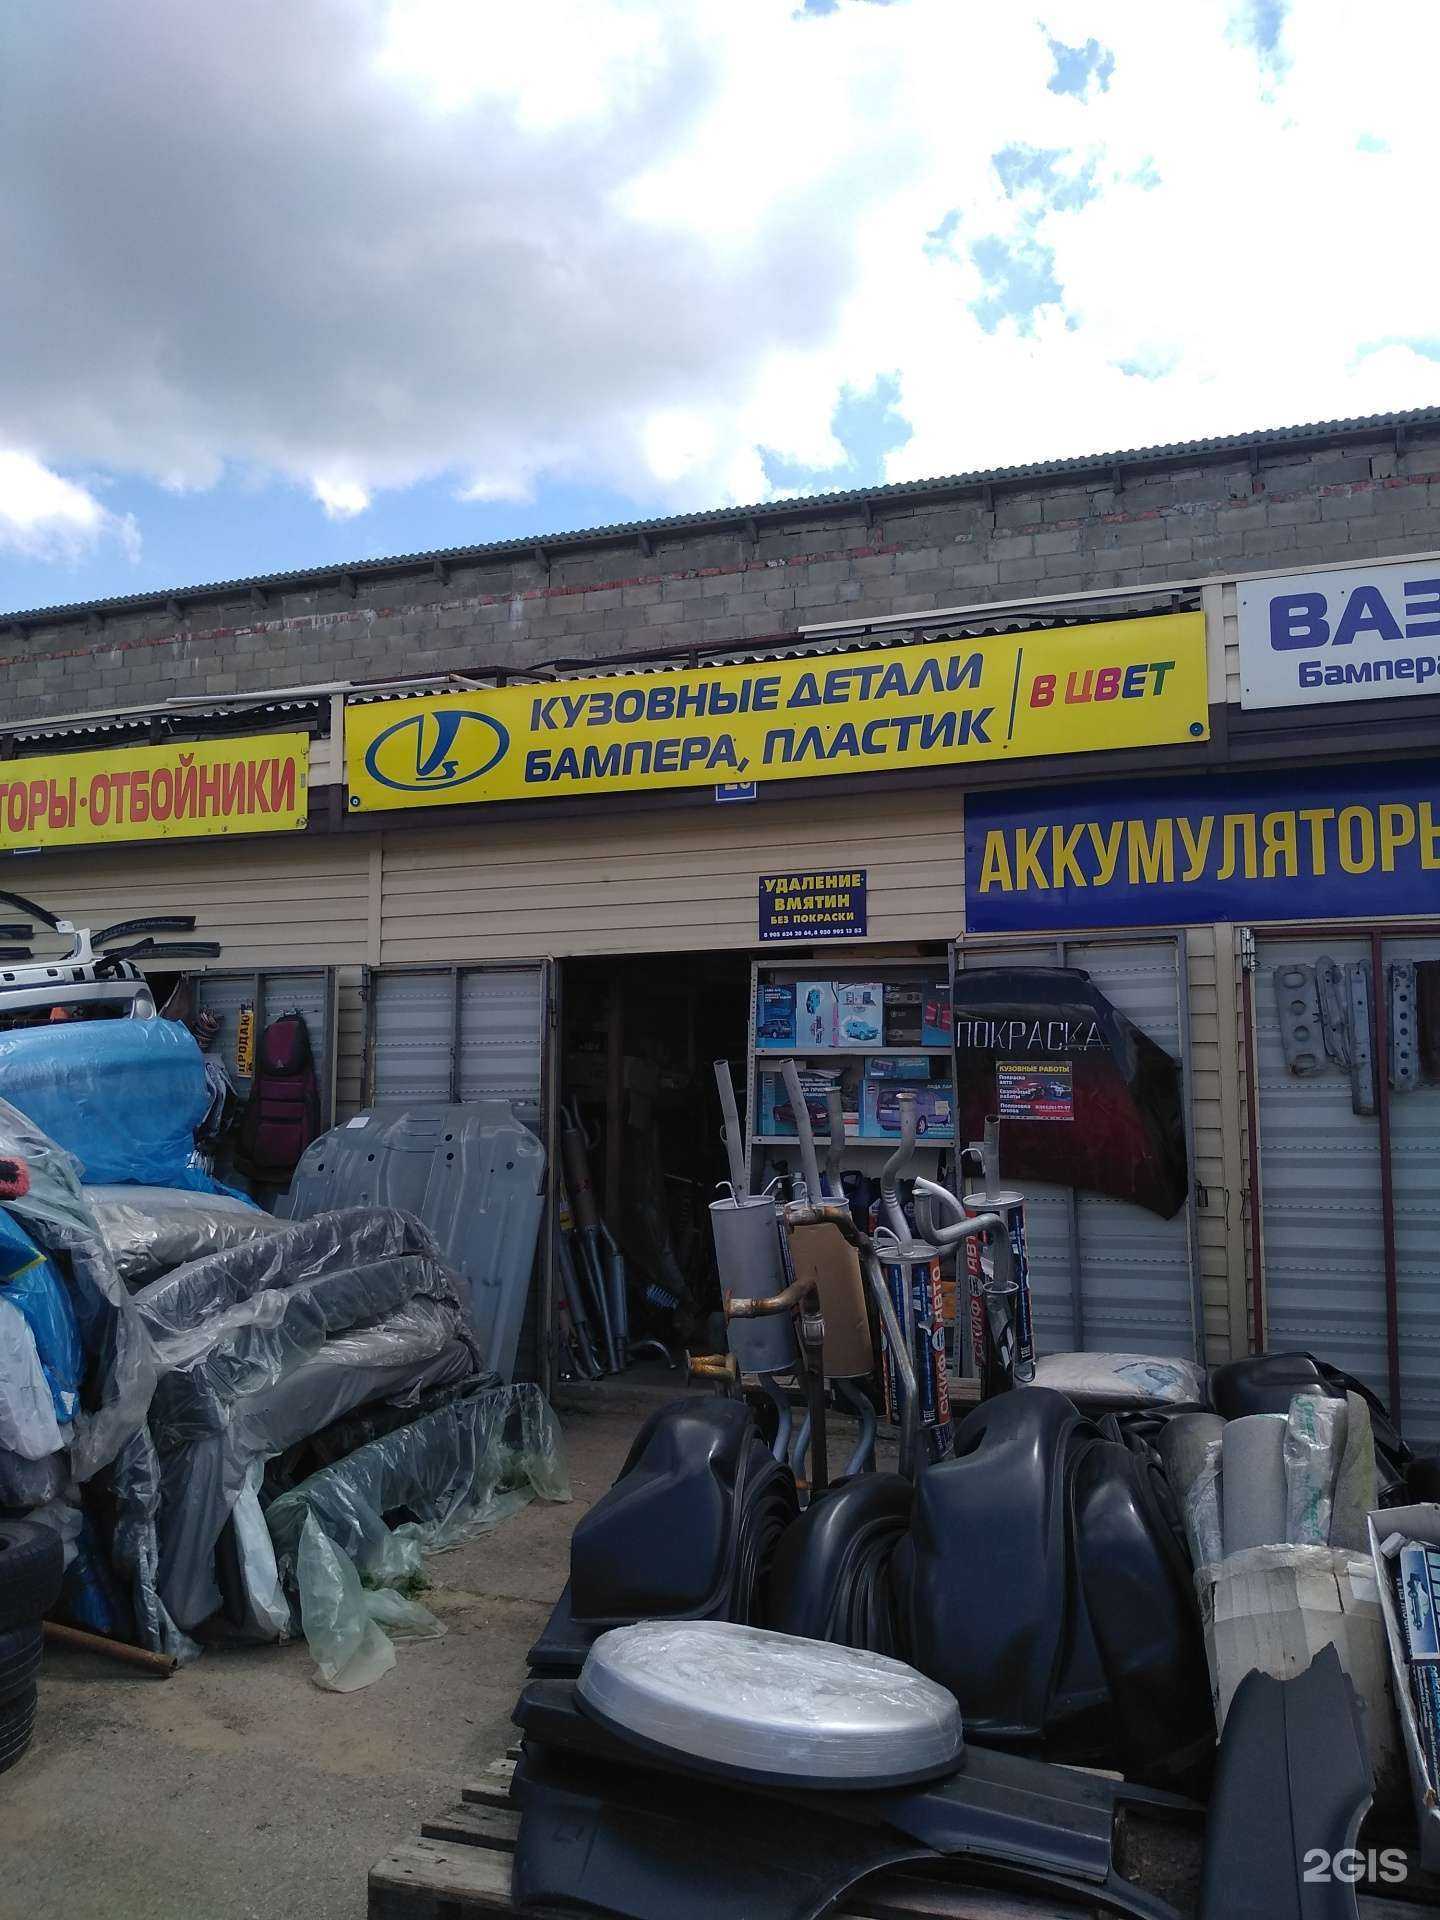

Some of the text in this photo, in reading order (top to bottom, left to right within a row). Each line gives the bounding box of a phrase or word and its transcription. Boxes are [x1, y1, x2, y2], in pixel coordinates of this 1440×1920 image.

[1299, 655, 1440, 688] Бампер
[530, 652, 1176, 732] КУЗОВНЫЕ ДЕТАЛИ В ЦВЕТ
[524, 707, 996, 783] БАМПЕРА, ПЛАСТИК
[764, 873, 861, 894] УДАЛЕНИЕ
[774, 894, 850, 911] ВМЯТИН
[770, 912, 855, 925] БЕЗ ПОКРАСКИ
[957, 1020, 1105, 1051] ПОКРАСКА
[999, 1065, 1070, 1073] КУЗОВНЫЕ РАБОТЫ
[937, 1355, 949, 1415] СКИФ
